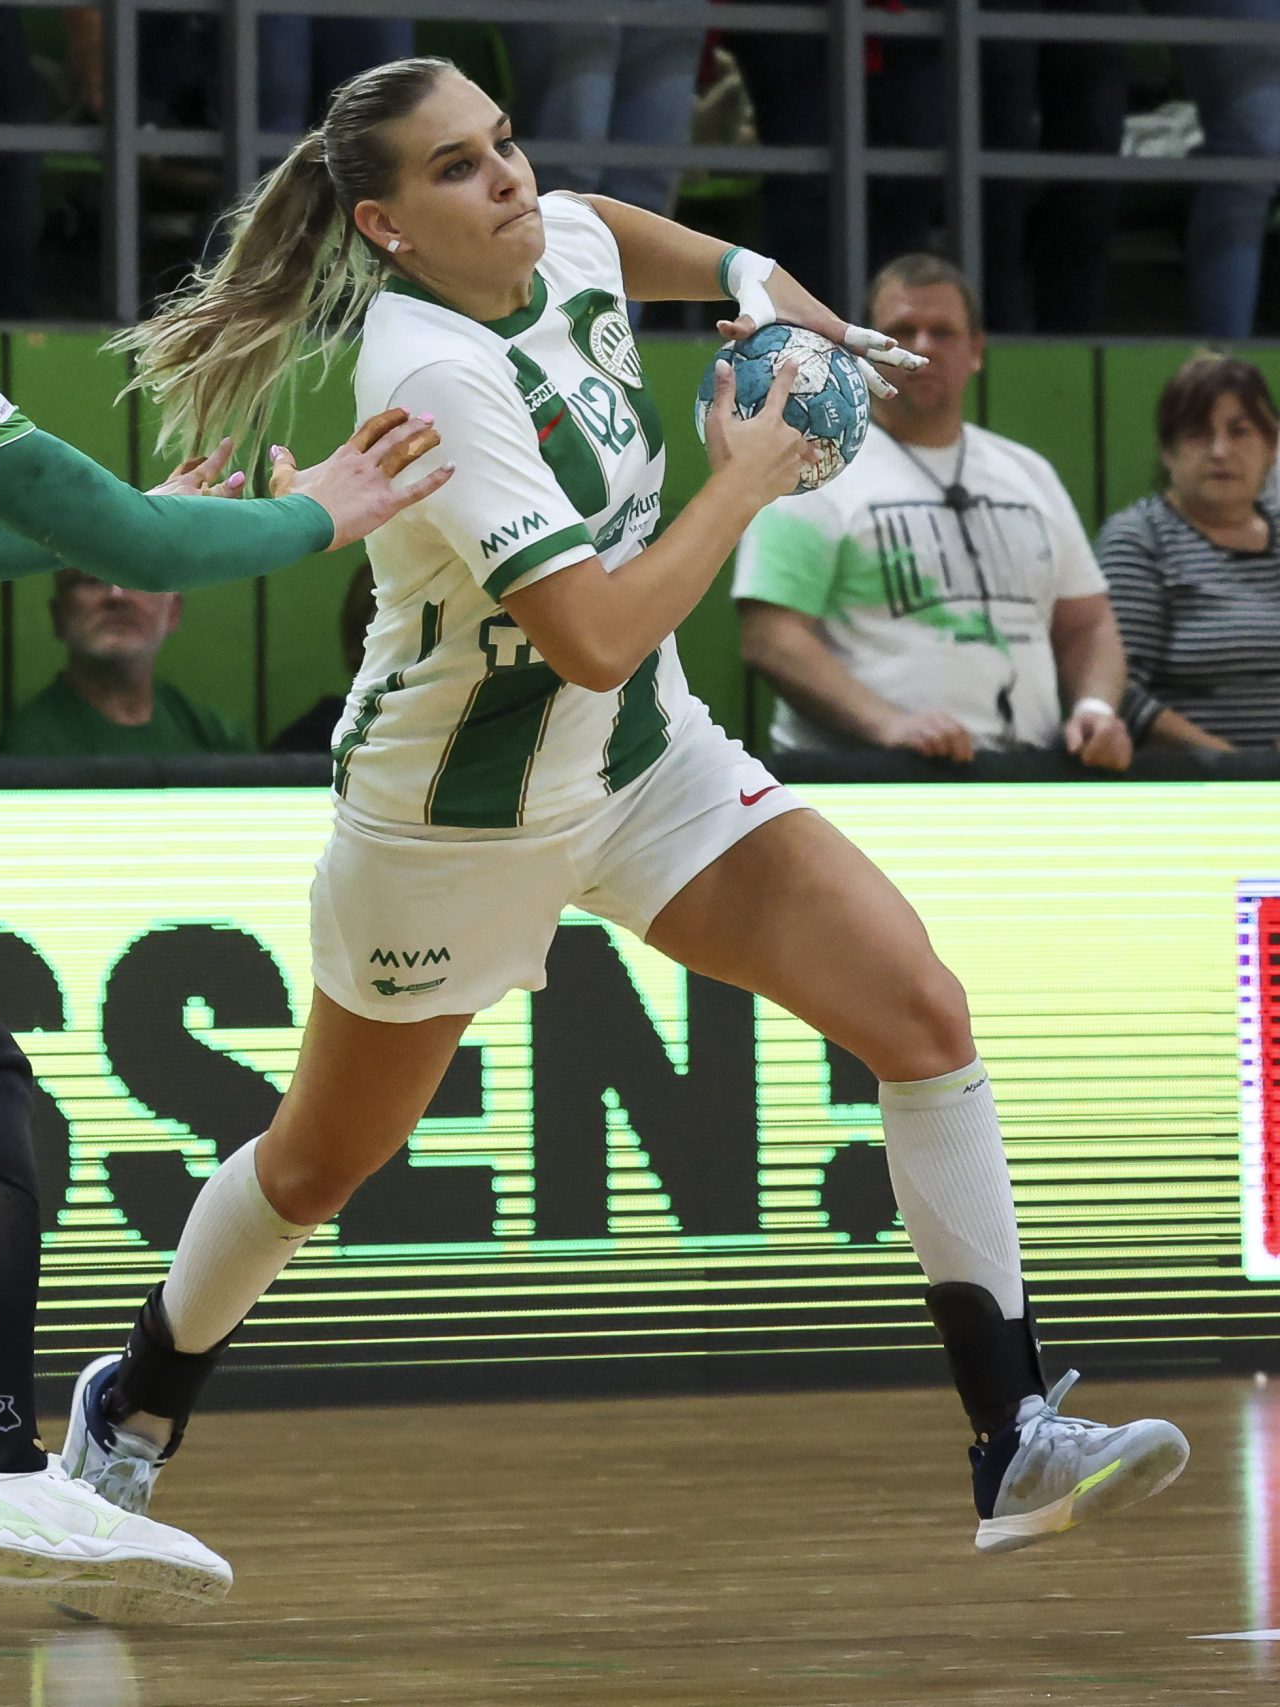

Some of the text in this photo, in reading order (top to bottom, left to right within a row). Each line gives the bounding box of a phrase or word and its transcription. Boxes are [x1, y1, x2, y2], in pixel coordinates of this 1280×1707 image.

[567, 376, 637, 456] 42
[480, 511, 549, 559] MVM
[370, 946, 451, 969] MVM
